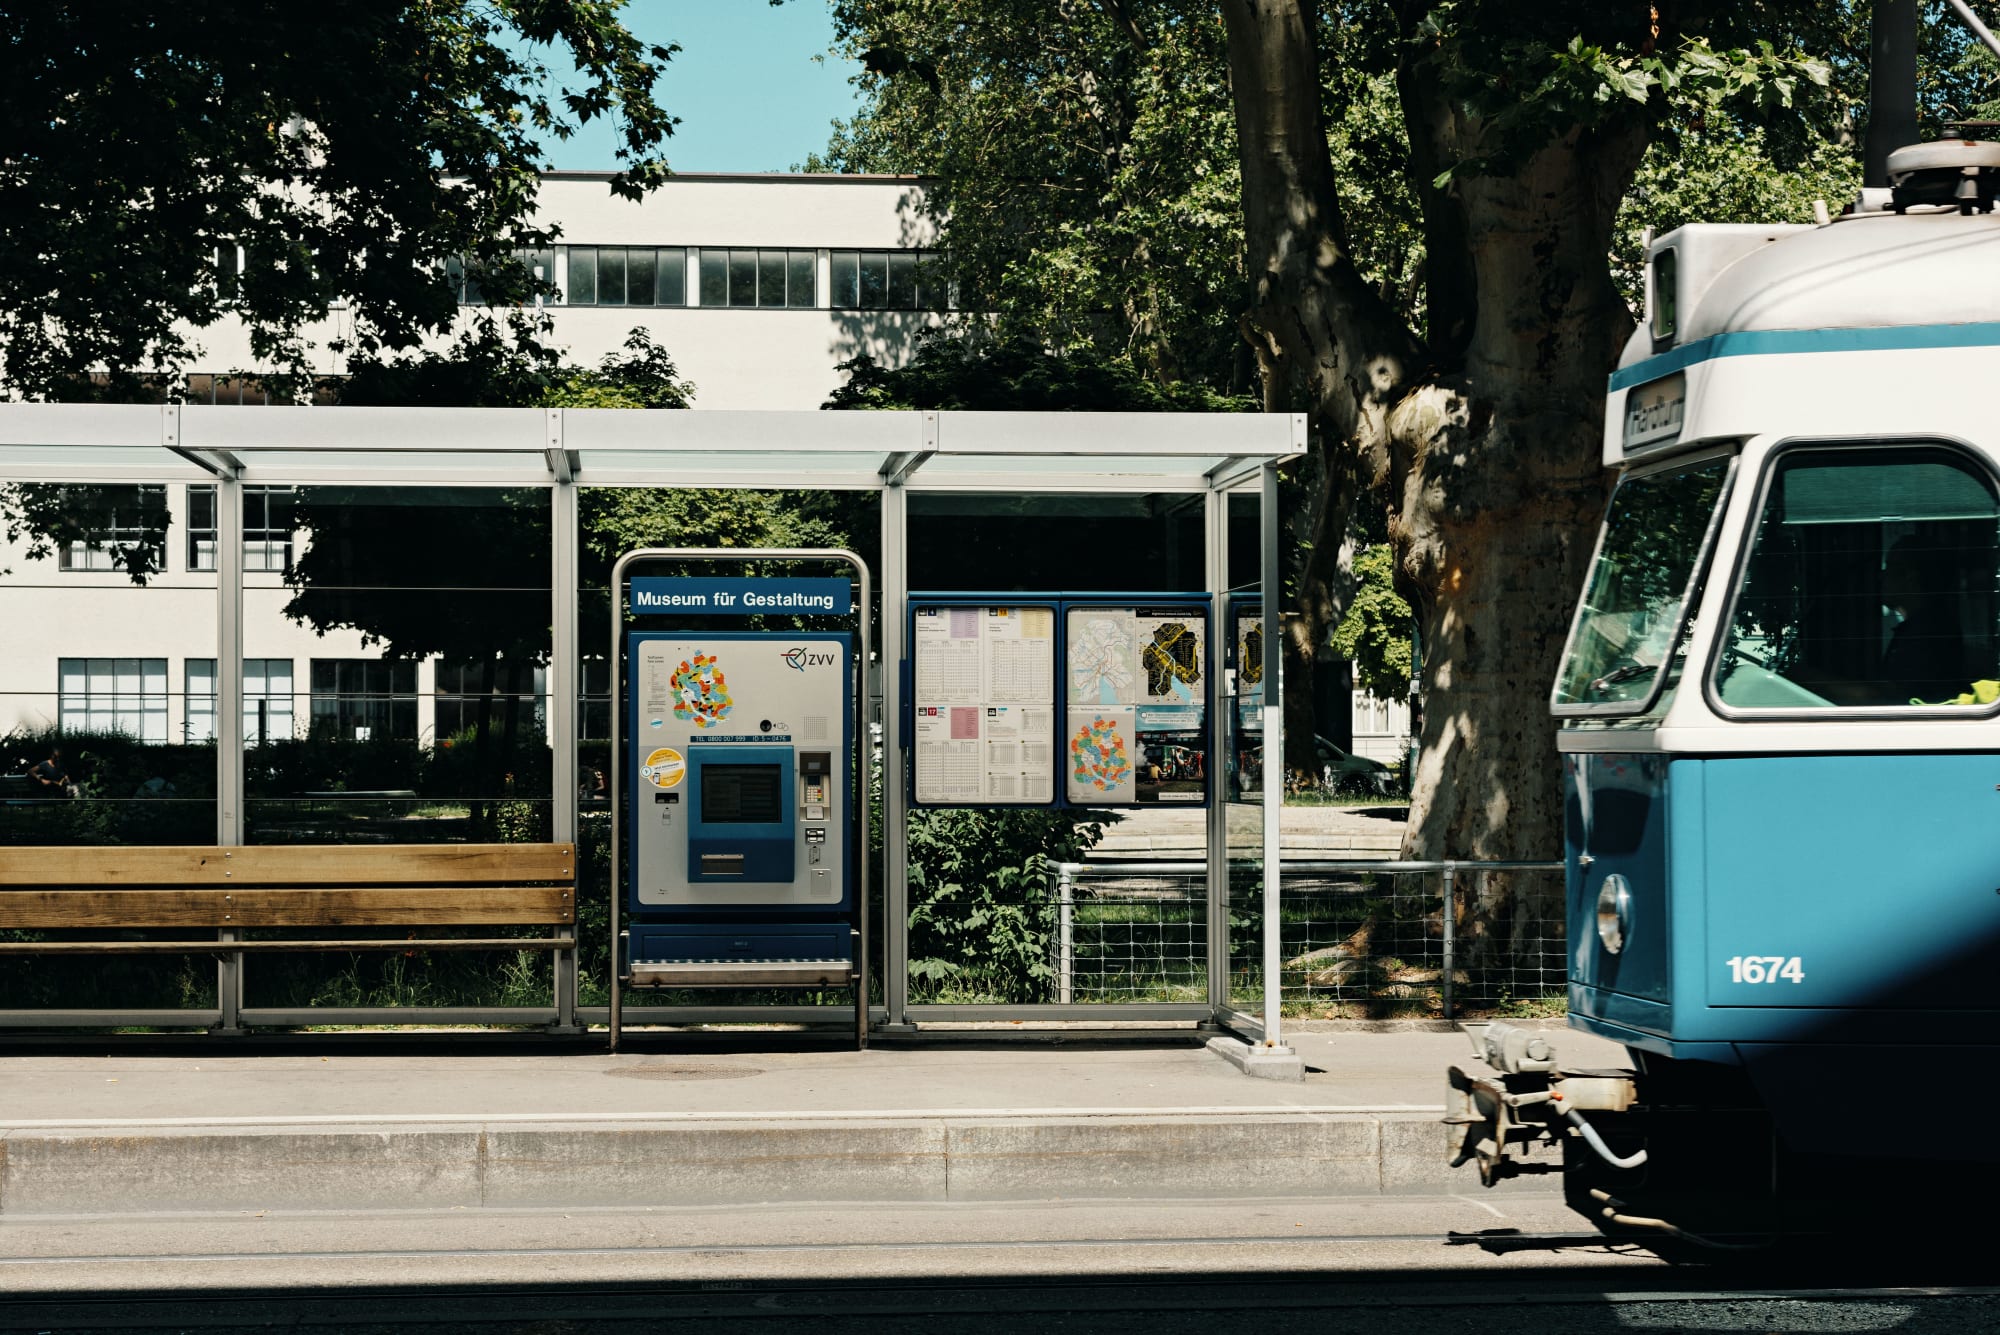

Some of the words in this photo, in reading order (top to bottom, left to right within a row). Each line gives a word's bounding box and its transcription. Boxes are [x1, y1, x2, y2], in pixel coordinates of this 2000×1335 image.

[637, 591, 706, 606] Museum
[713, 592, 736, 606] für
[743, 592, 834, 609] Gestaltung
[808, 654, 835, 666] ZVV
[1726, 956, 1805, 984] 1674
